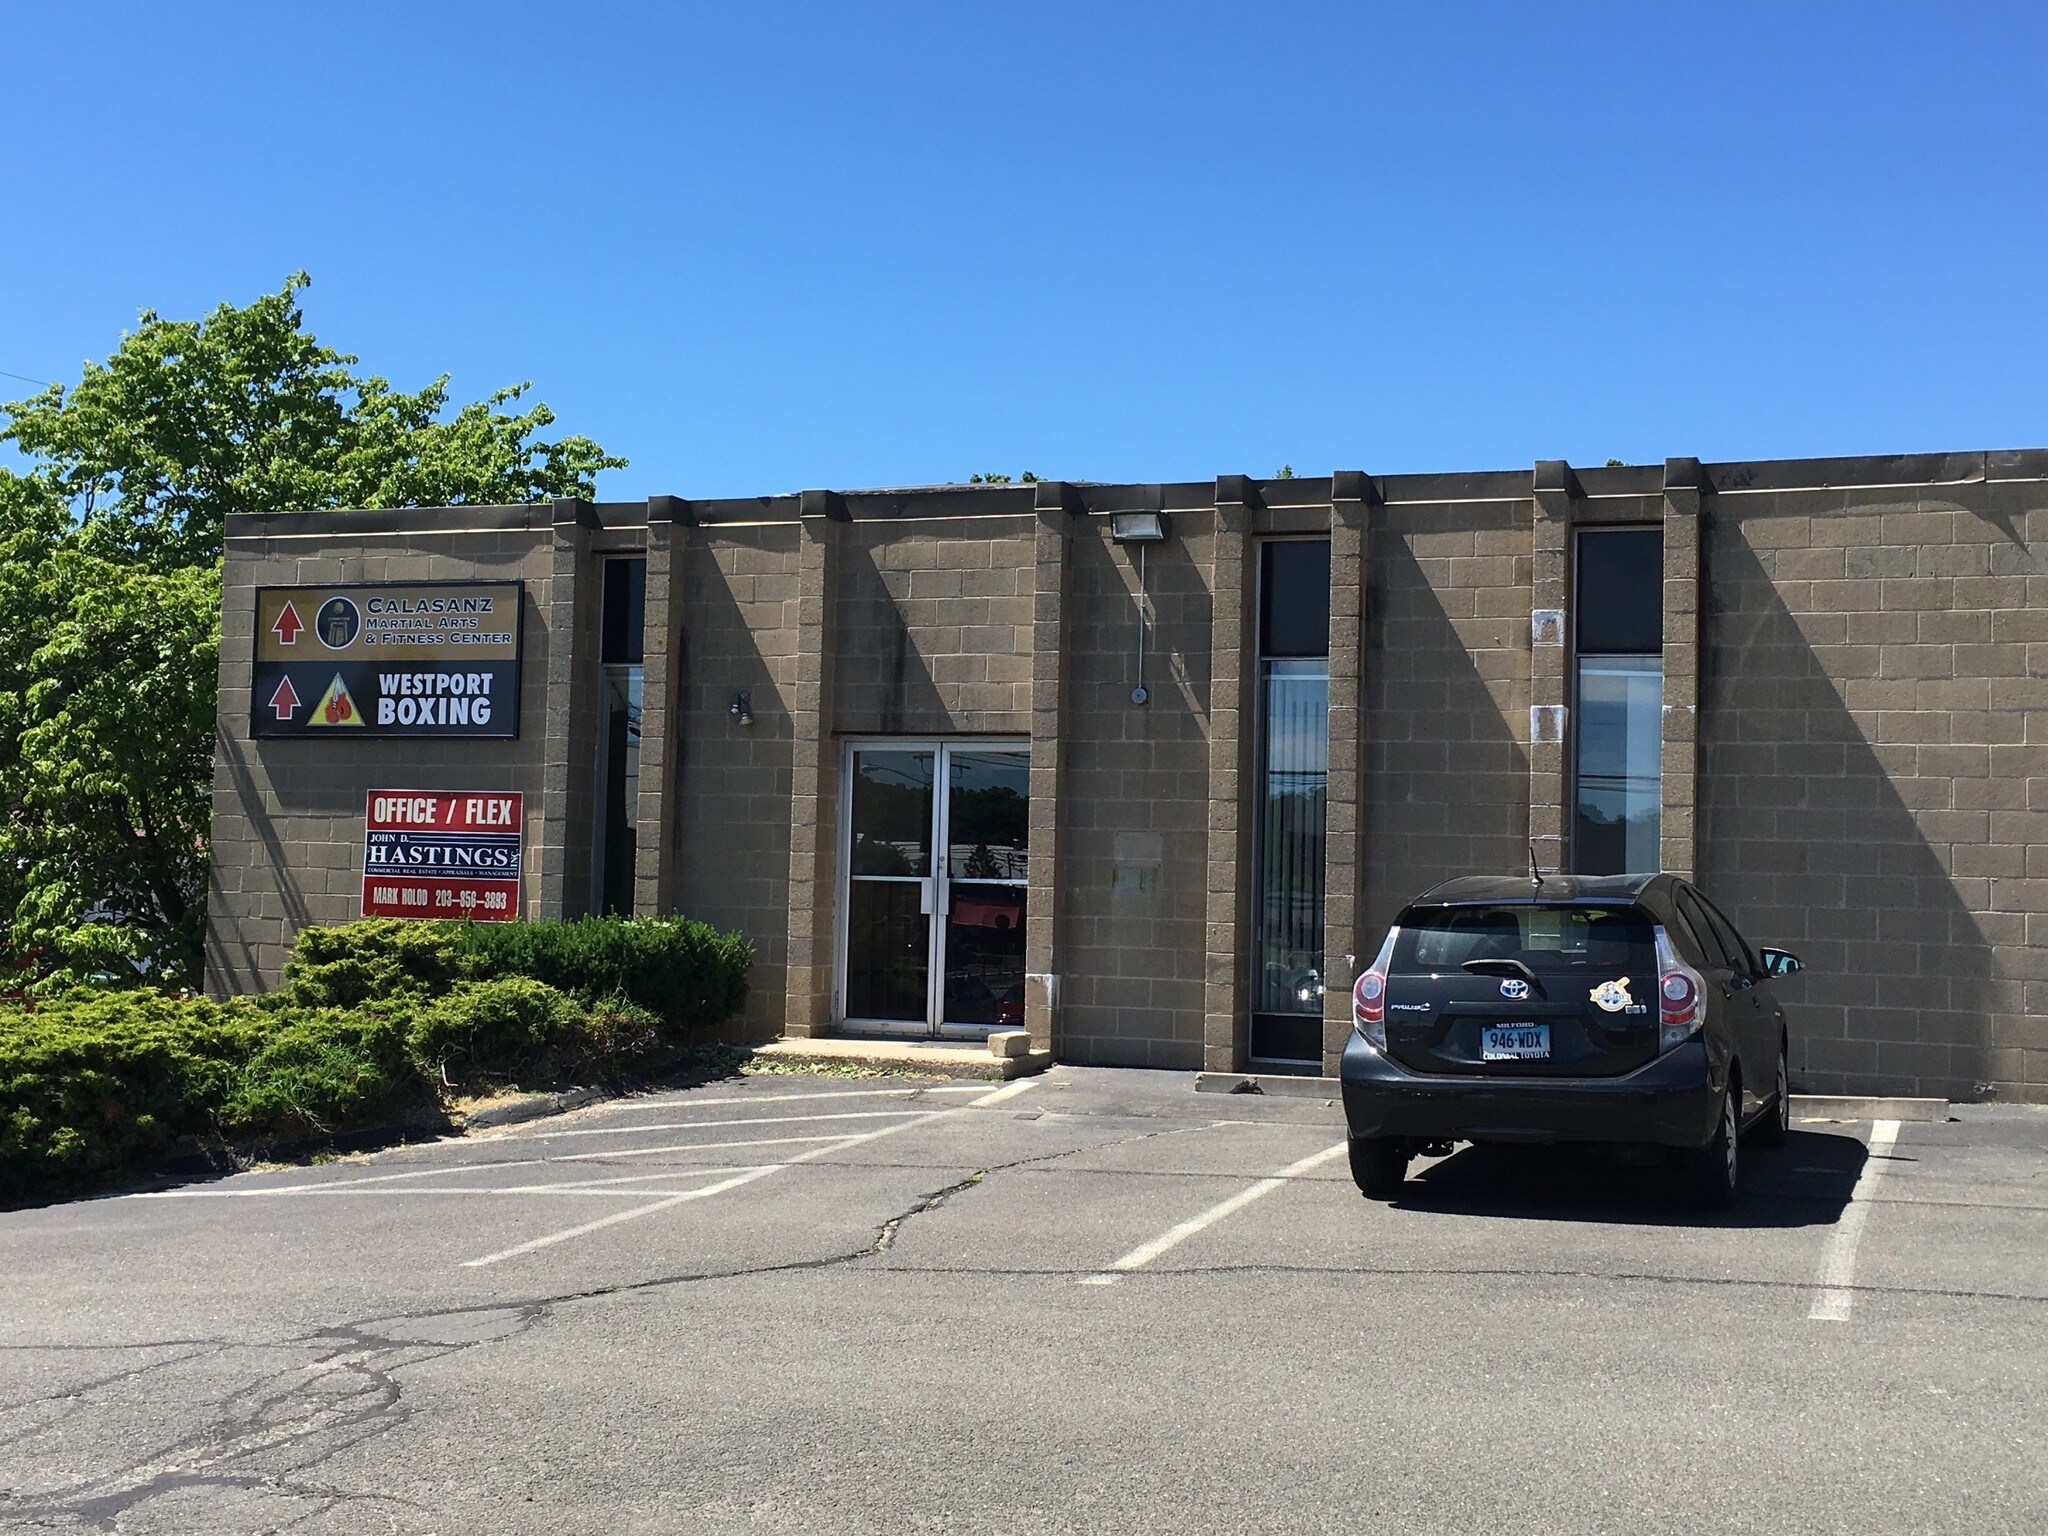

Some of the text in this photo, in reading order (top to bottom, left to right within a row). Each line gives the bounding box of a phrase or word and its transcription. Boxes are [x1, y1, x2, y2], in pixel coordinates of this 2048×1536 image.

[366, 597, 493, 614] CALASANZ
[365, 617, 479, 629] MARTIAL ARTS
[364, 631, 512, 645] & FITNESS CENTER
[379, 673, 493, 695] WESTPORT
[377, 697, 491, 726] BOXING
[374, 797, 513, 825] OFFICE / FLEX
[370, 833, 409, 843] JOHN D.
[368, 845, 508, 867] HASTINGS
[373, 886, 399, 905] MARK
[402, 888, 428, 906] HOLOD
[1495, 1021, 1535, 1029] MILFORD
[1482, 1051, 1550, 1060] COLONIAL TOYOTA
